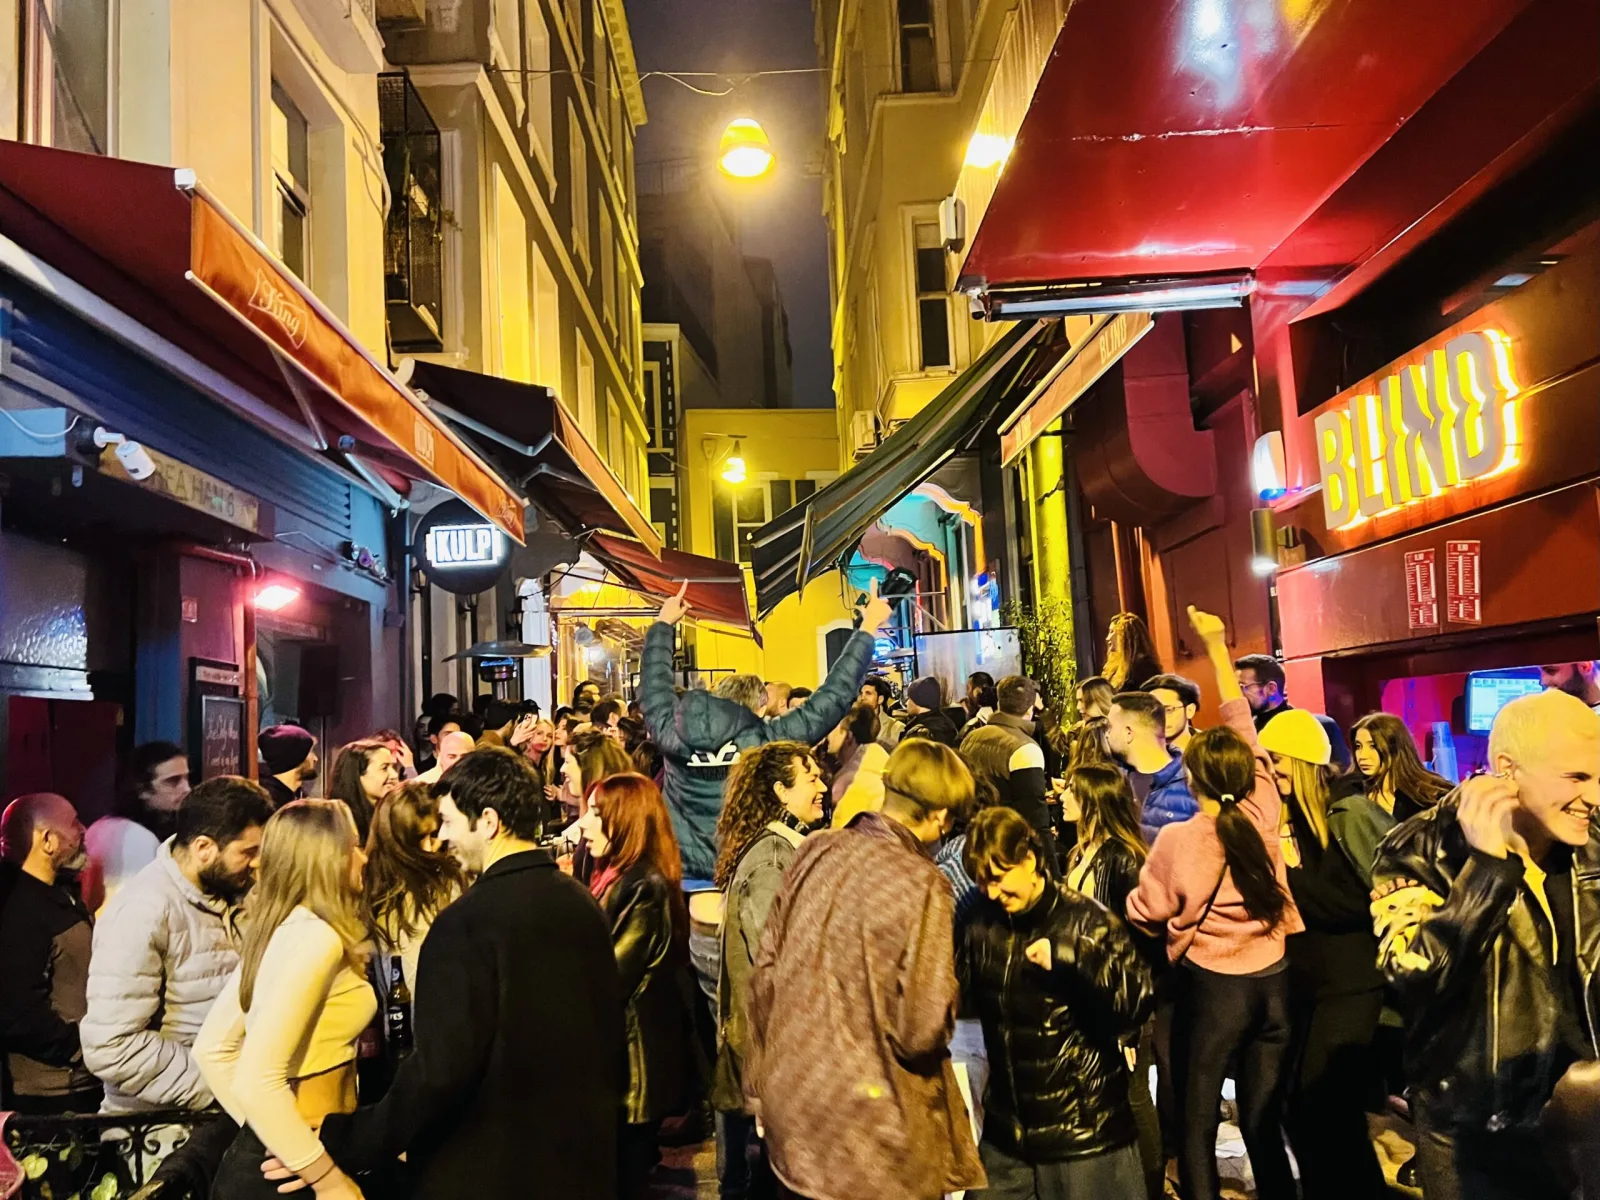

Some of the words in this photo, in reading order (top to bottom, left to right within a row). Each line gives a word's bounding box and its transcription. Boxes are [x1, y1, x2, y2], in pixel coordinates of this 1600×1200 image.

[1100, 313, 1127, 365] BLIND
[1314, 331, 1504, 530] BLIND
[435, 529, 492, 563] KULP
